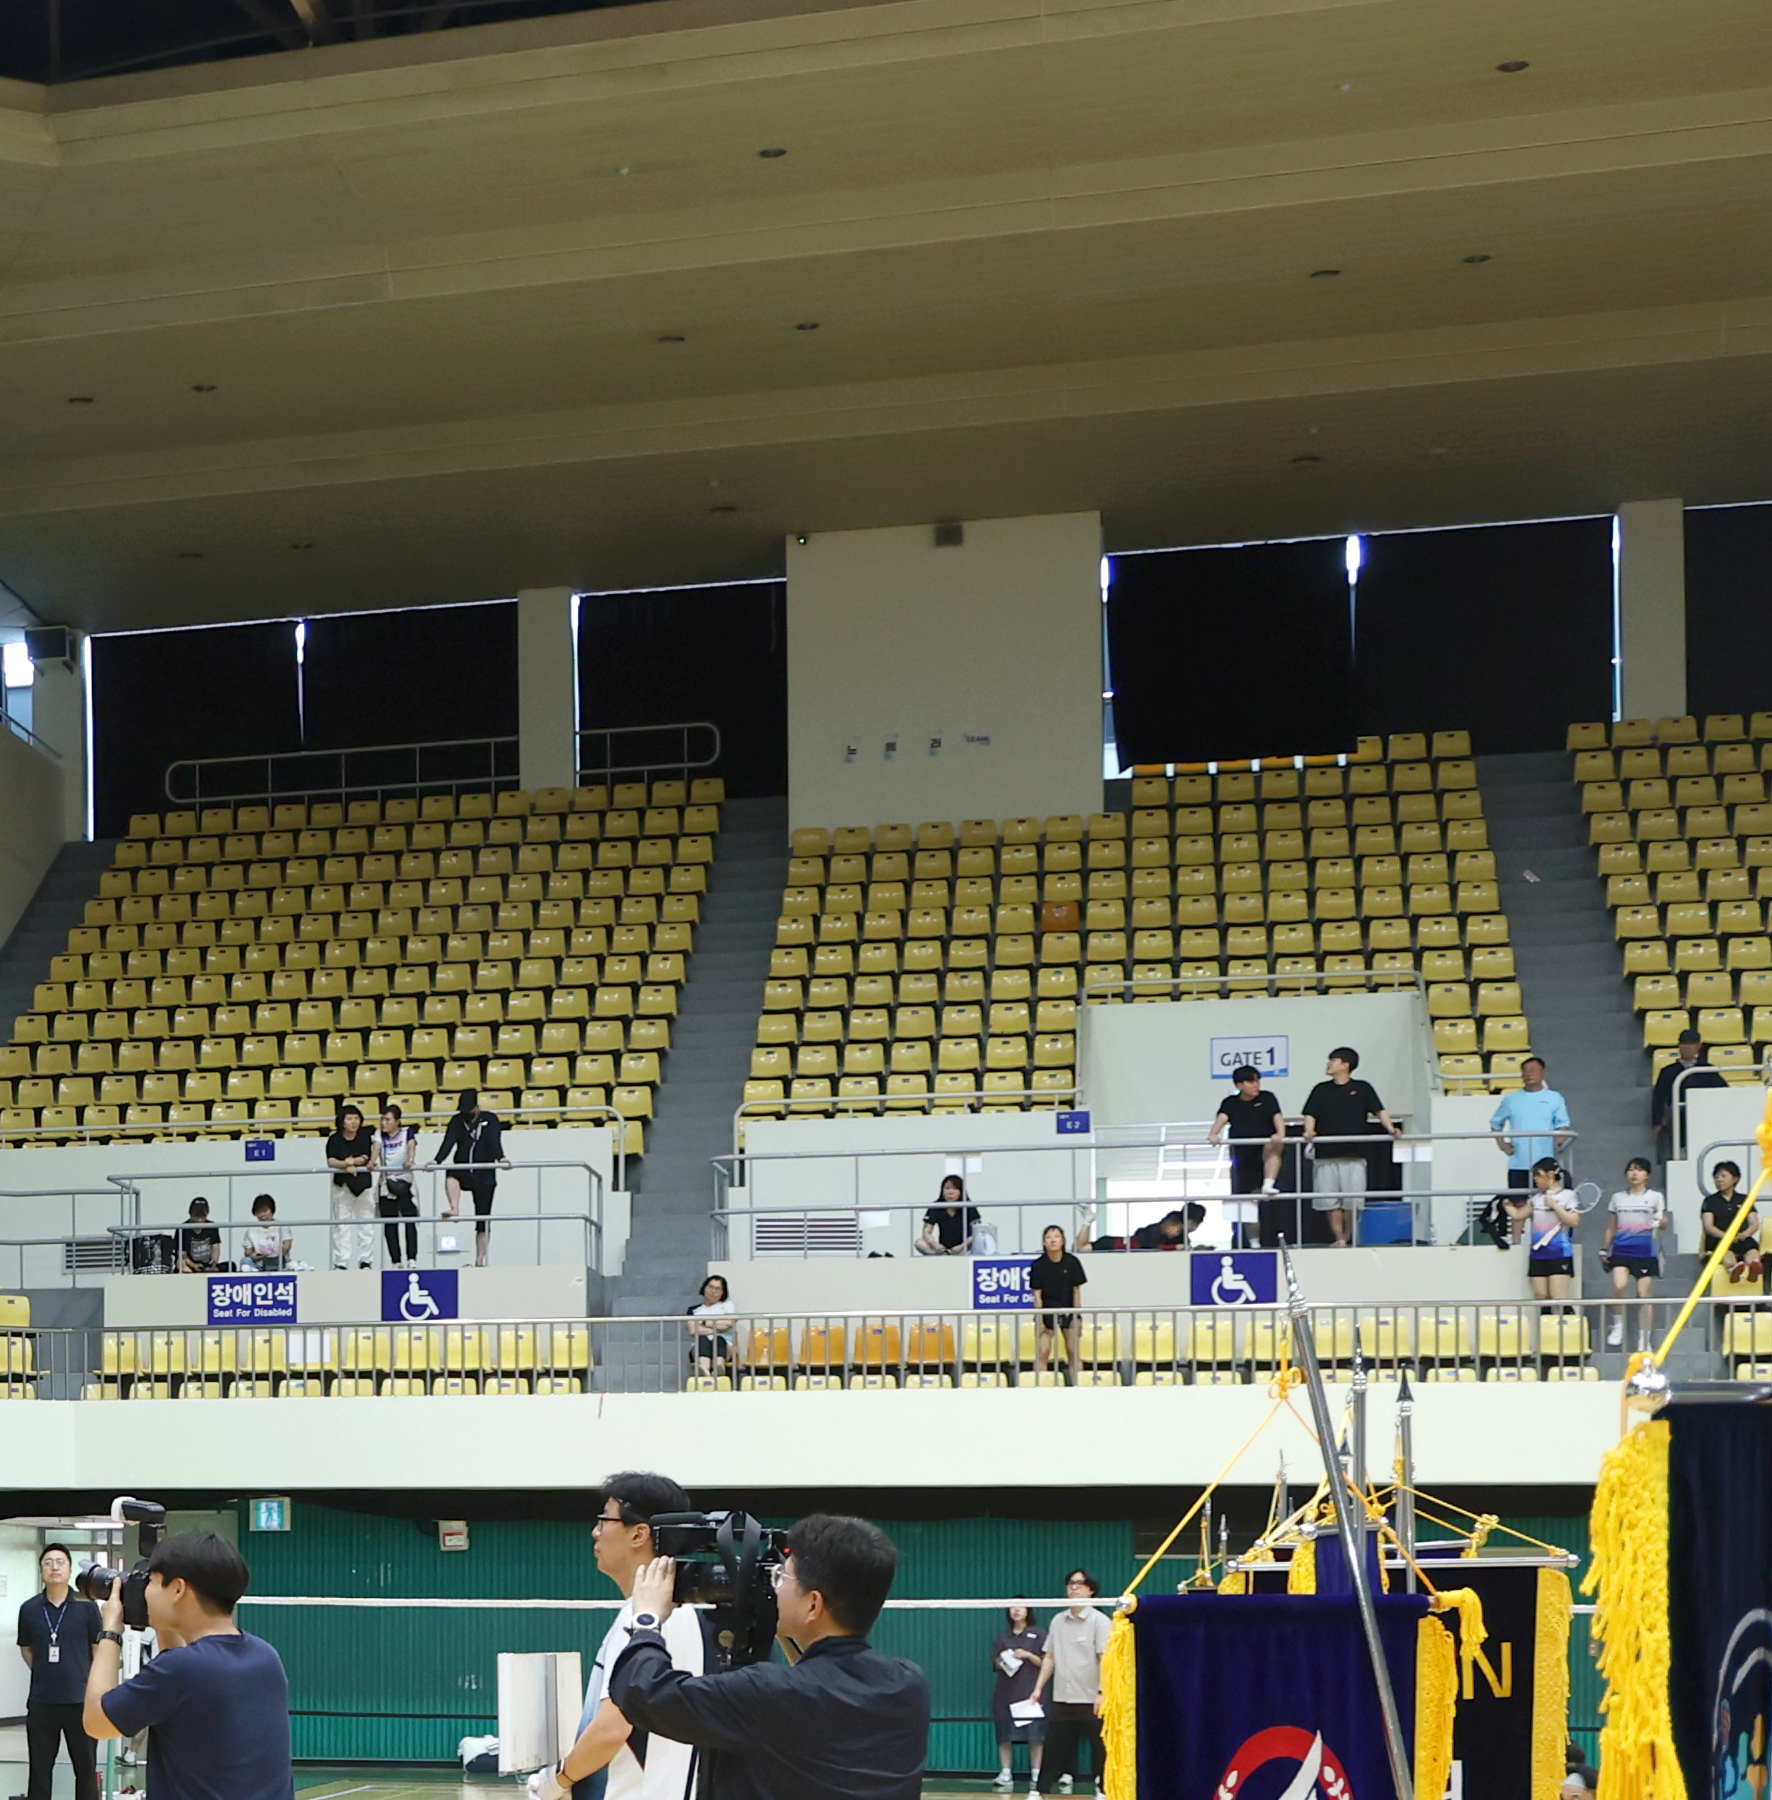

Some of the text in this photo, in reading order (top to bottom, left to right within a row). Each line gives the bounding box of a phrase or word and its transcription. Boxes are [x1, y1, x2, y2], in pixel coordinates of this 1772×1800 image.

[1220, 1046, 1275, 1066] GATE 1
[211, 1282, 295, 1307] 장애인석
[979, 1294, 1000, 1304] Seat
[1004, 1294, 1019, 1303] For
[213, 1307, 293, 1318] Seat For Disabled
